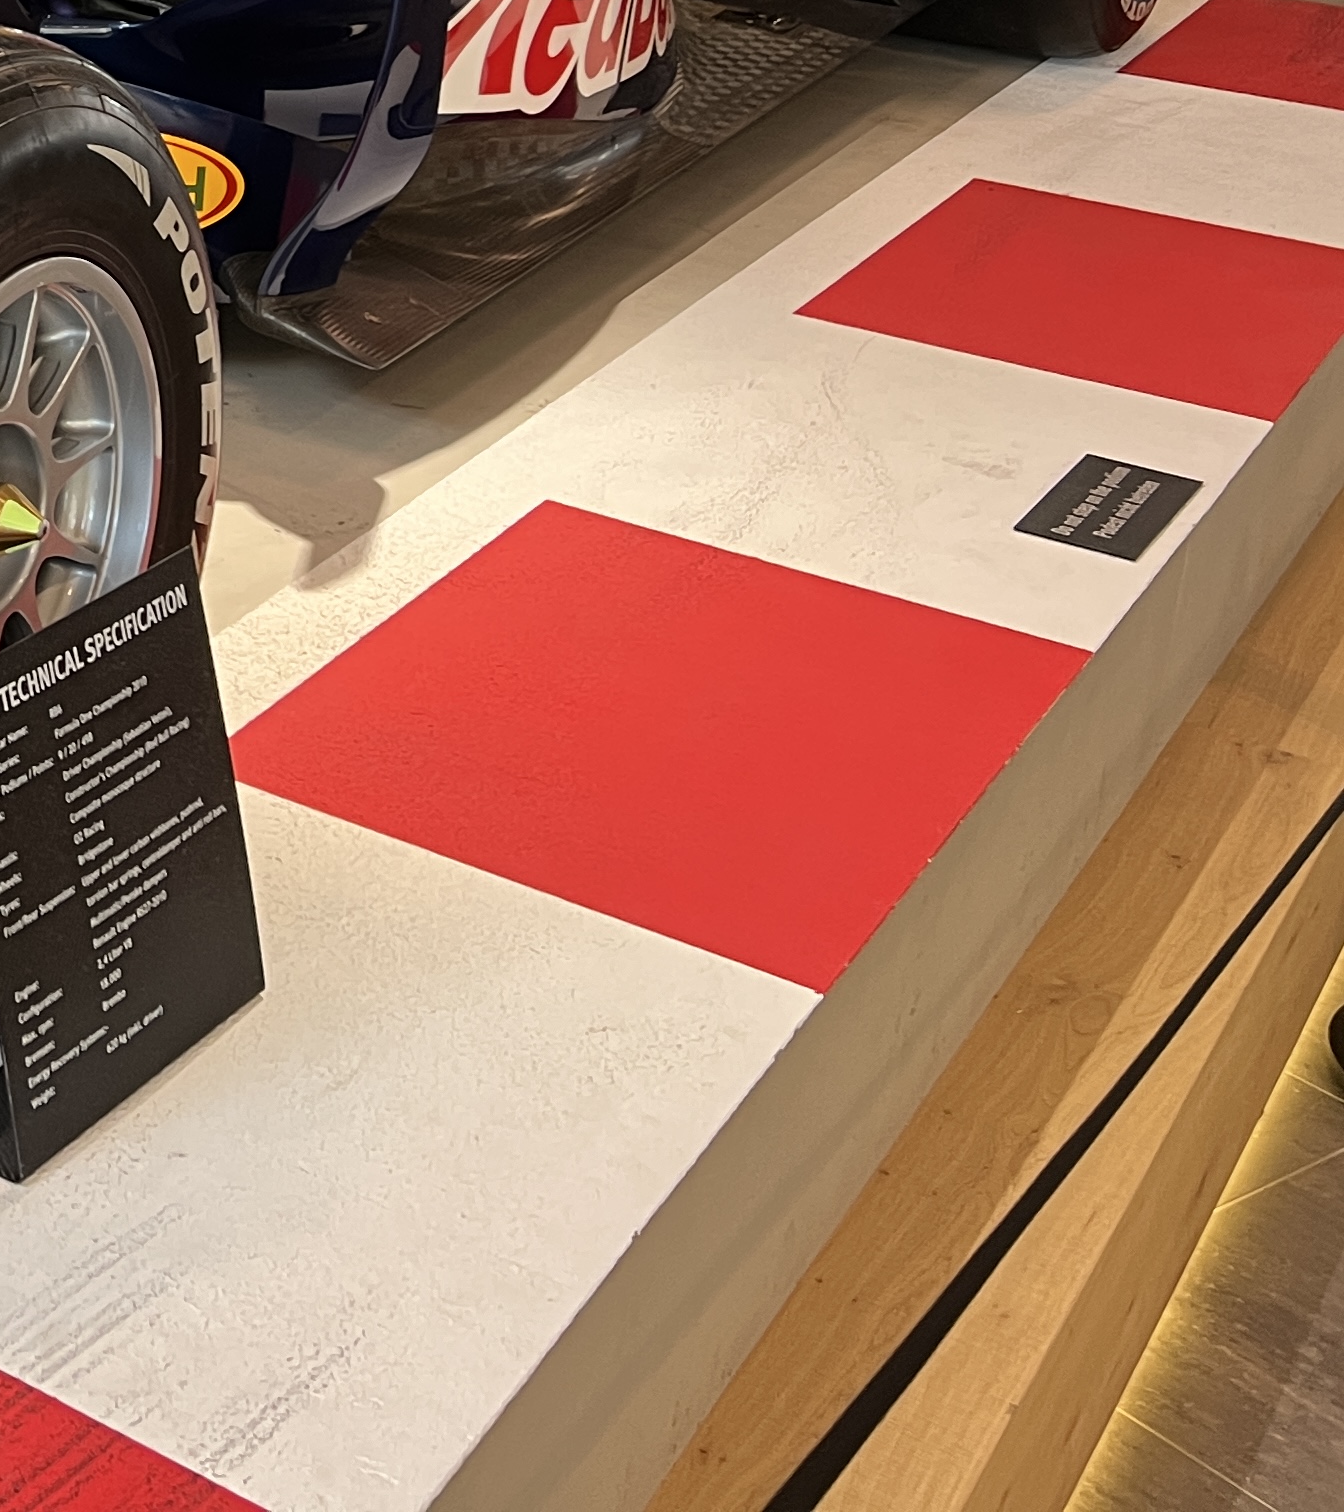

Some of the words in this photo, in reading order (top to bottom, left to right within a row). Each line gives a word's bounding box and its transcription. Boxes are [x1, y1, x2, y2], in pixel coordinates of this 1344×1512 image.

[152, 196, 223, 568] POTEN
[1063, 514, 1085, 528] not
[83, 583, 189, 664] SPECIFICATION
[54, 718, 81, 740] Formula
[79, 710, 93, 724] One
[92, 686, 133, 716] Championship
[6, 725, 29, 744] Name:
[82, 738, 123, 769] Championship
[105, 747, 145, 778] Championship
[82, 819, 105, 839] Racing
[77, 837, 114, 866] Bridgestone
